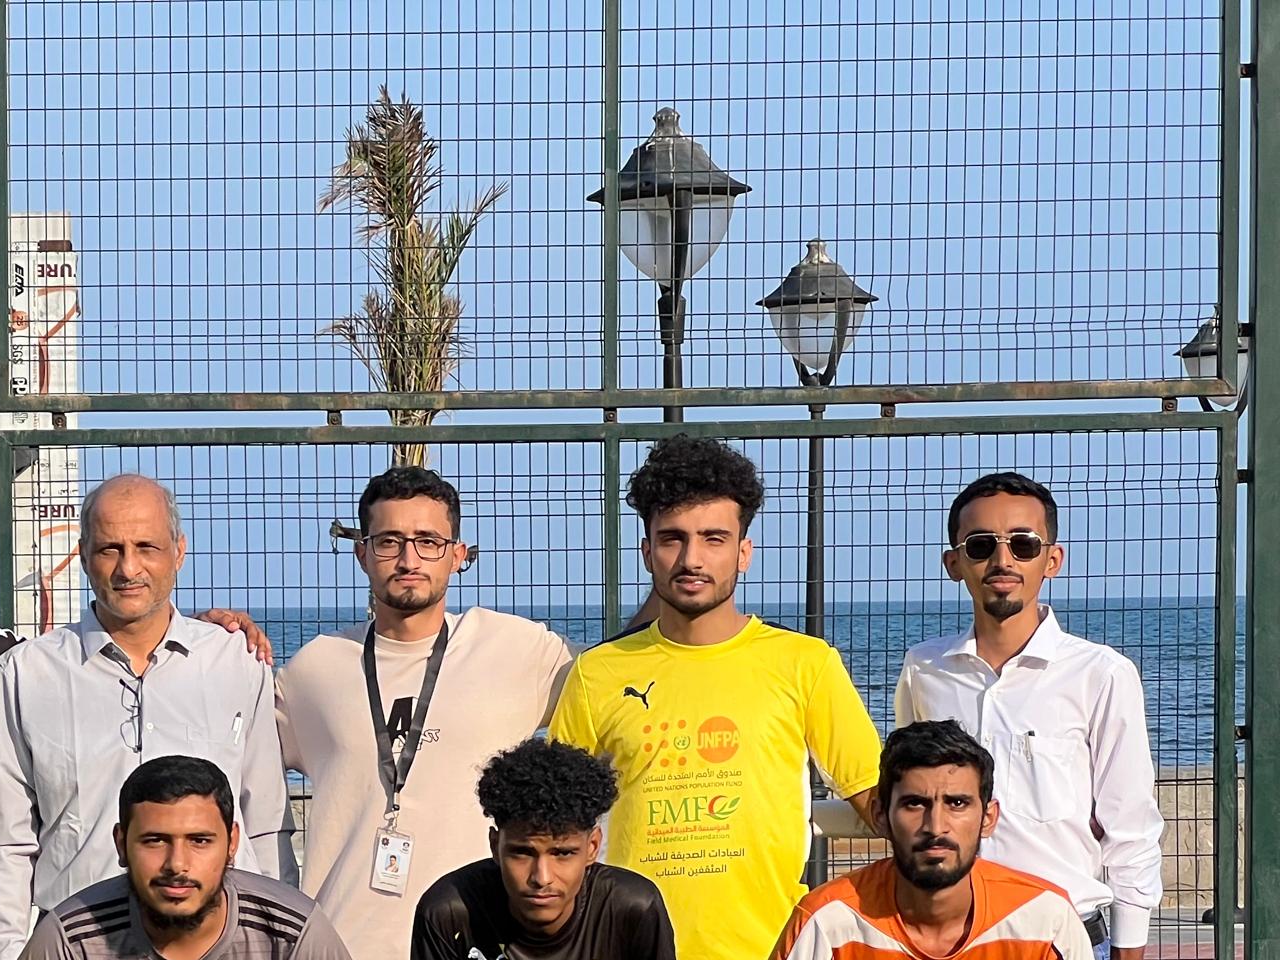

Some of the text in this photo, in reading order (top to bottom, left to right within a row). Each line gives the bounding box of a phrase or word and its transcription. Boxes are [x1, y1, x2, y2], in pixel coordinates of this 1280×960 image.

[37, 263, 77, 279] URE
[40, 505, 78, 518] URE
[642, 768, 742, 785] صندوق الأمم المتحدة للسكان
[663, 835, 688, 843] Medical
[639, 848, 745, 864] العيادات الصديقة للشباب
[656, 864, 727, 879] المثقفين الشباب
